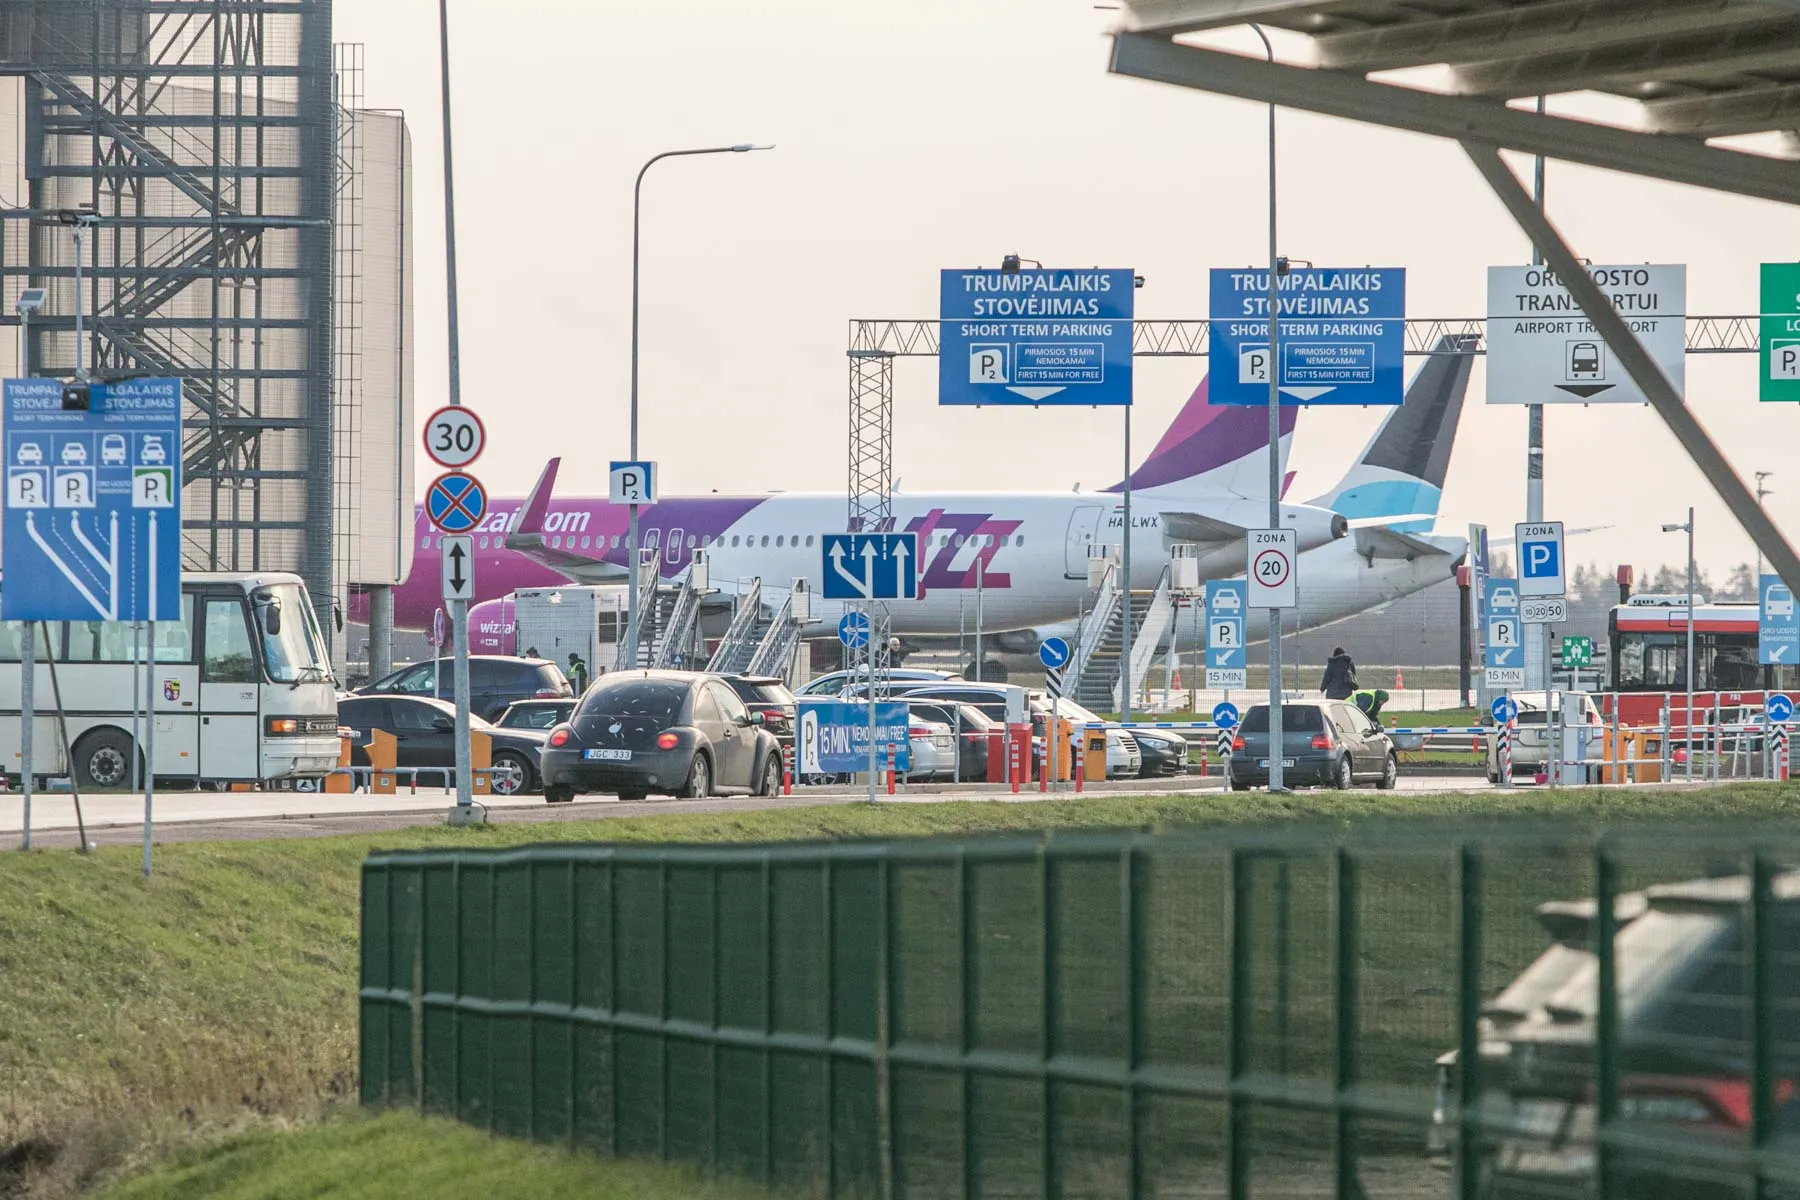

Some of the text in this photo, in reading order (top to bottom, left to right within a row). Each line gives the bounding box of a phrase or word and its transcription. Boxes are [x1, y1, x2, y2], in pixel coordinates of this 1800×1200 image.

[1231, 274, 1382, 291] TRUMPALAIKIS
[1588, 269, 1649, 286] OSTO
[962, 275, 1111, 292] TRUMPALAIKIS
[974, 294, 1099, 316] STOVĖJIMAS
[1243, 293, 1370, 315] STOVĖJIMAS
[1516, 293, 1658, 311] TRANRTUI
[961, 324, 1113, 337] SHORT TERM PARKING
[1230, 324, 1383, 336] SHOR TERM PARKING
[1515, 322, 1573, 333] AIRPORT
[1024, 348, 1095, 356] PIRMOSIOS 15 MIN
[1294, 348, 1365, 356] PIRMOSIOS 15 MIN
[1036, 357, 1086, 365] NEMOKAMAI
[1306, 357, 1357, 365] NEMOKAMAI
[1018, 371, 1100, 379] FIRST 15 MIN FOR FREE
[1288, 371, 1370, 379] FIRST 15 MIN FOR FREE
[106, 385, 174, 396] ILGALAIKIS
[435, 423, 474, 452] 30
[1108, 517, 1158, 528] HALWX
[1525, 527, 1554, 536] ZONA
[1256, 533, 1286, 543] ZONA
[1530, 545, 1550, 574] P
[1262, 560, 1281, 576] 20
[1535, 607, 1546, 616] 20
[1548, 606, 1562, 616] 50
[1209, 672, 1220, 681] 15
[1488, 671, 1498, 680] 15
[820, 727, 830, 754] 15
[590, 750, 630, 759] JGC 333
